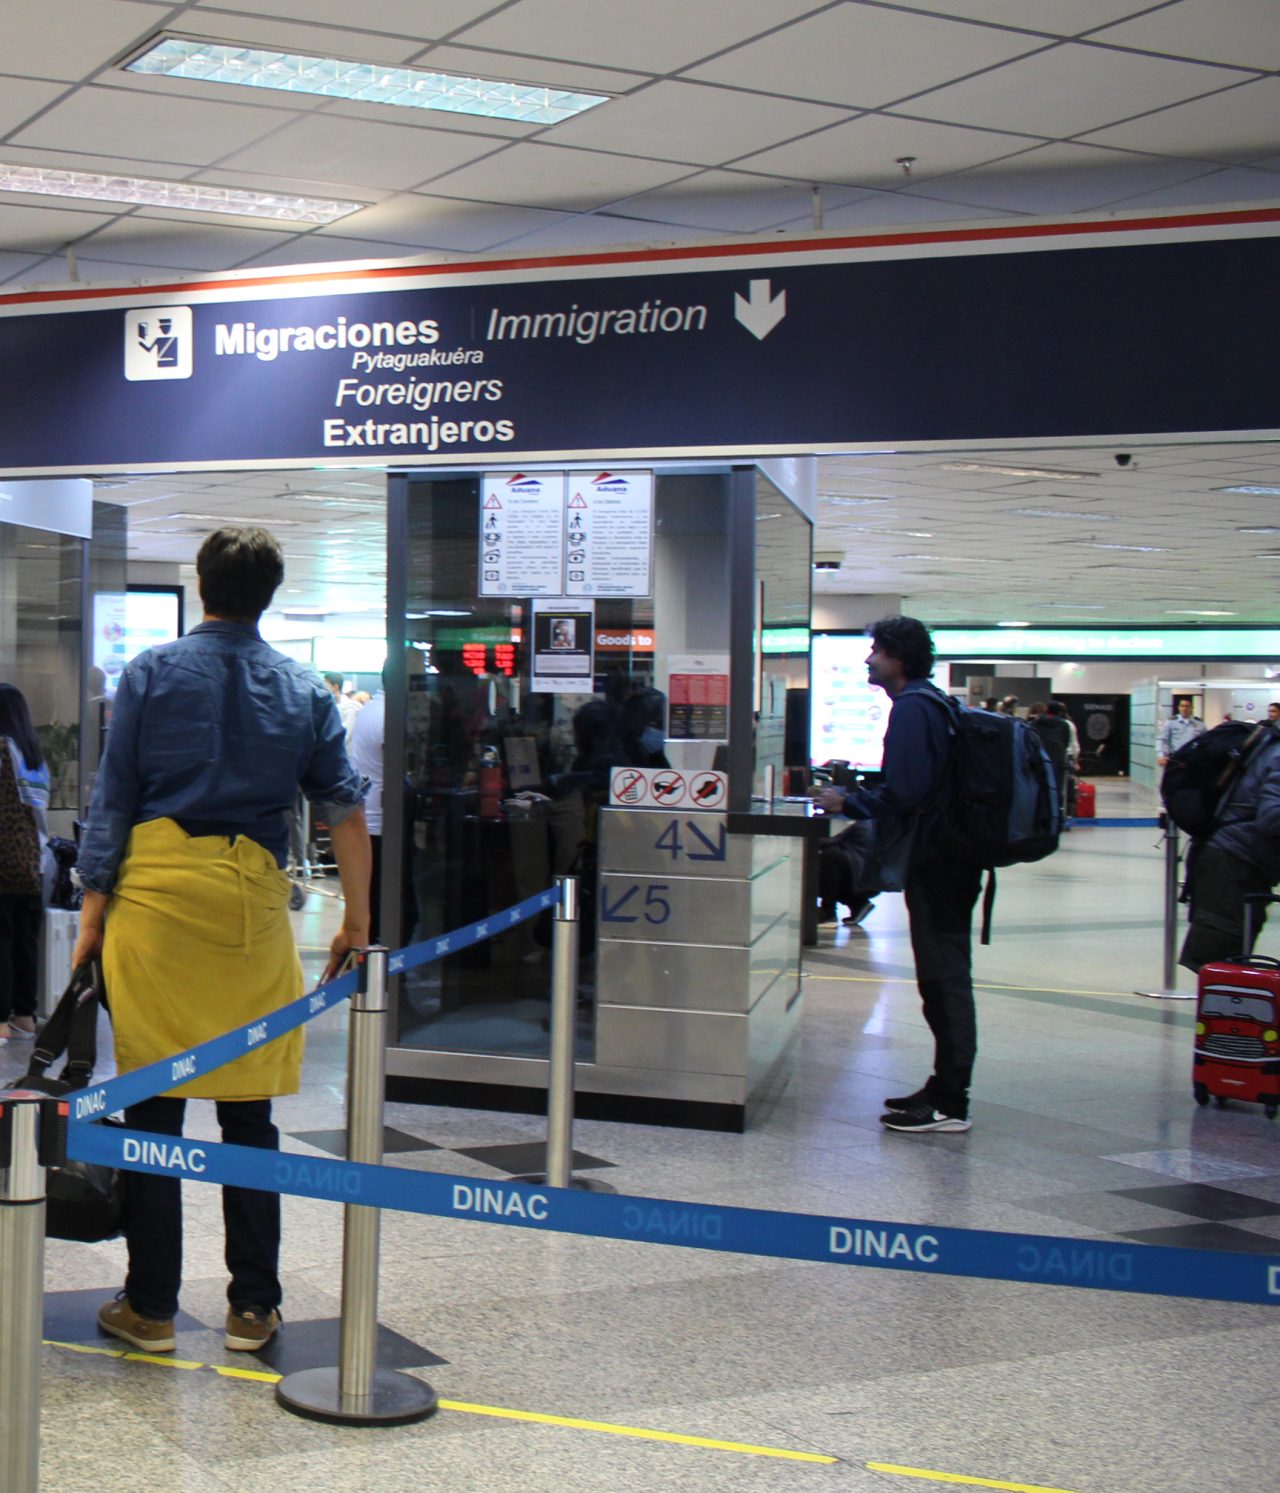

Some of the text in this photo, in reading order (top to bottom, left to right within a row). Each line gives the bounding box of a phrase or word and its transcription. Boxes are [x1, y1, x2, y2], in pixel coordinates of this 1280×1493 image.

[214, 302, 708, 362] Migraciones Immigration
[352, 347, 484, 373] Pytaguakuéra
[335, 376, 504, 411] Foreigners
[323, 415, 515, 451] Extranjeros
[597, 634, 652, 646] Goods to
[655, 819, 683, 859] 4
[643, 885, 670, 925] 5
[248, 1022, 268, 1046] DINAC
[172, 1055, 197, 1081] DINAC
[76, 1089, 107, 1119] DINAC
[123, 1138, 207, 1173] DINAC
[453, 1184, 549, 1221] DINAC
[829, 1226, 940, 1263] DINAC
